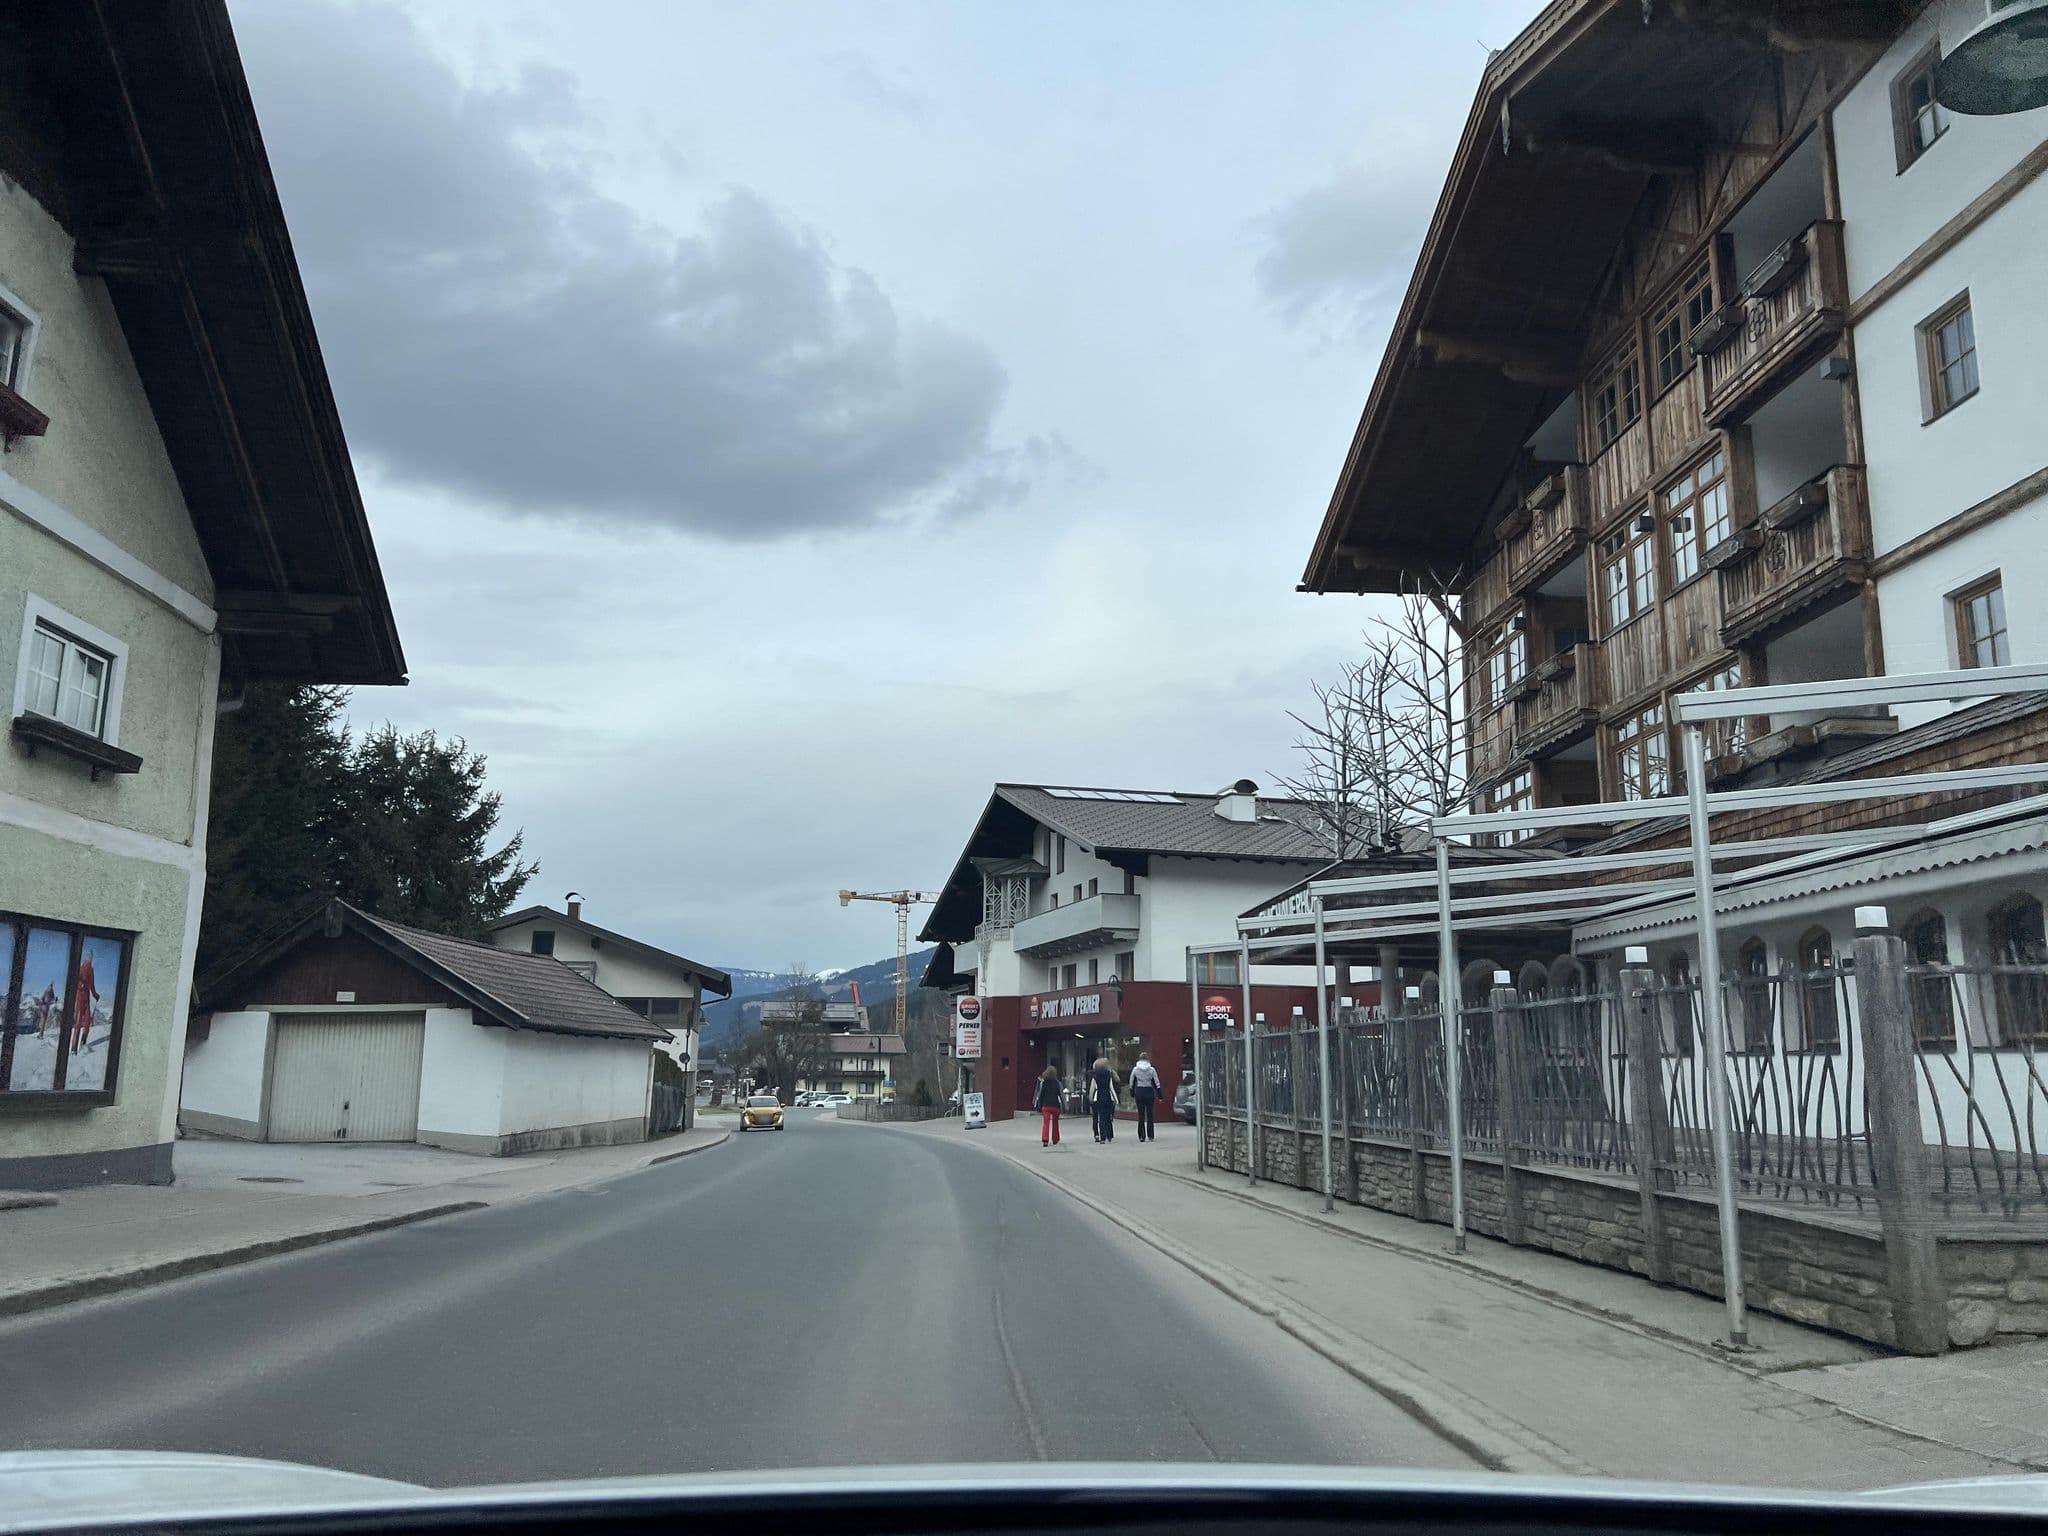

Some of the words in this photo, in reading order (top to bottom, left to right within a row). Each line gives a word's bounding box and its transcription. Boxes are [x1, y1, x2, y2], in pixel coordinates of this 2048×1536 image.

[1041, 999, 1059, 1019] SPORT
[1060, 996, 1075, 1017] 2000
[1205, 1005, 1232, 1013] SPORT
[1207, 1012, 1229, 1020] 2000
